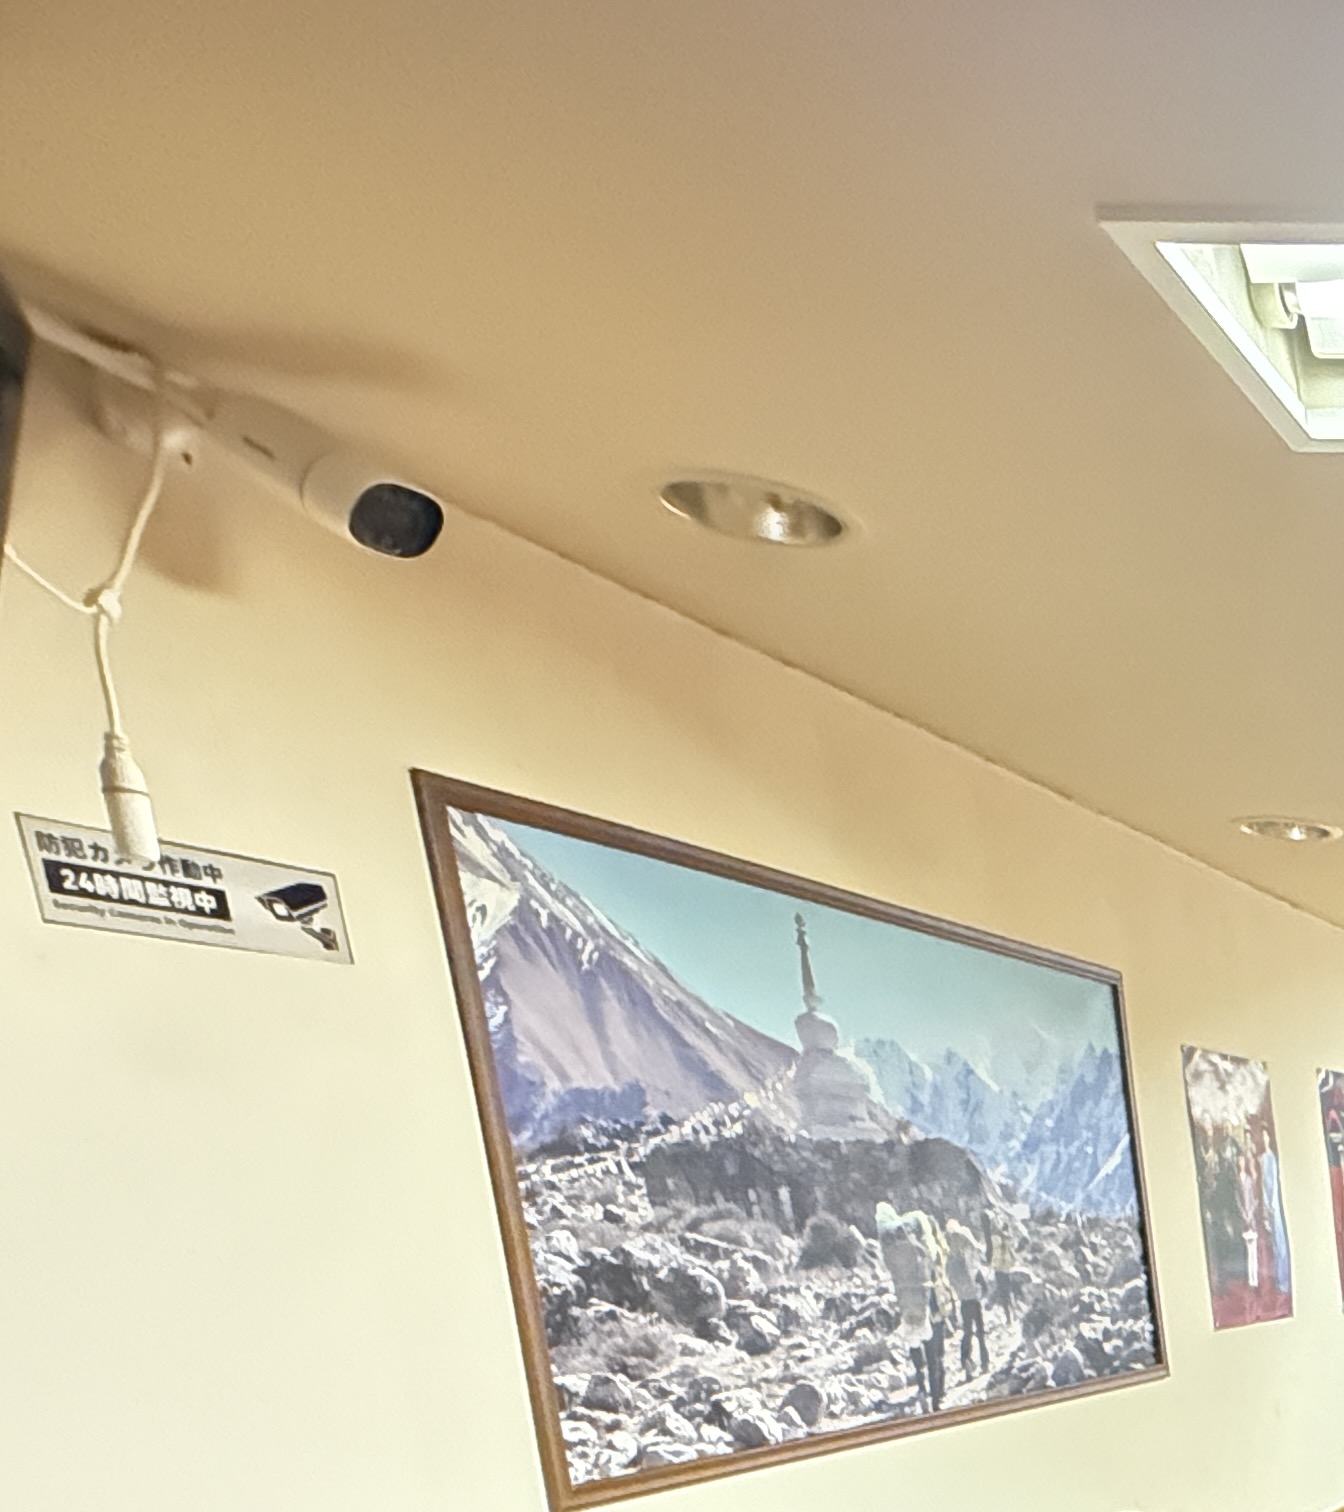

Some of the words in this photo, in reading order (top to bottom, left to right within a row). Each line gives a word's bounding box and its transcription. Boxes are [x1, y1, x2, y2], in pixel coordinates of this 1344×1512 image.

[35, 831, 224, 884] 防犯カ作動中
[59, 868, 218, 914] 24時間監視中
